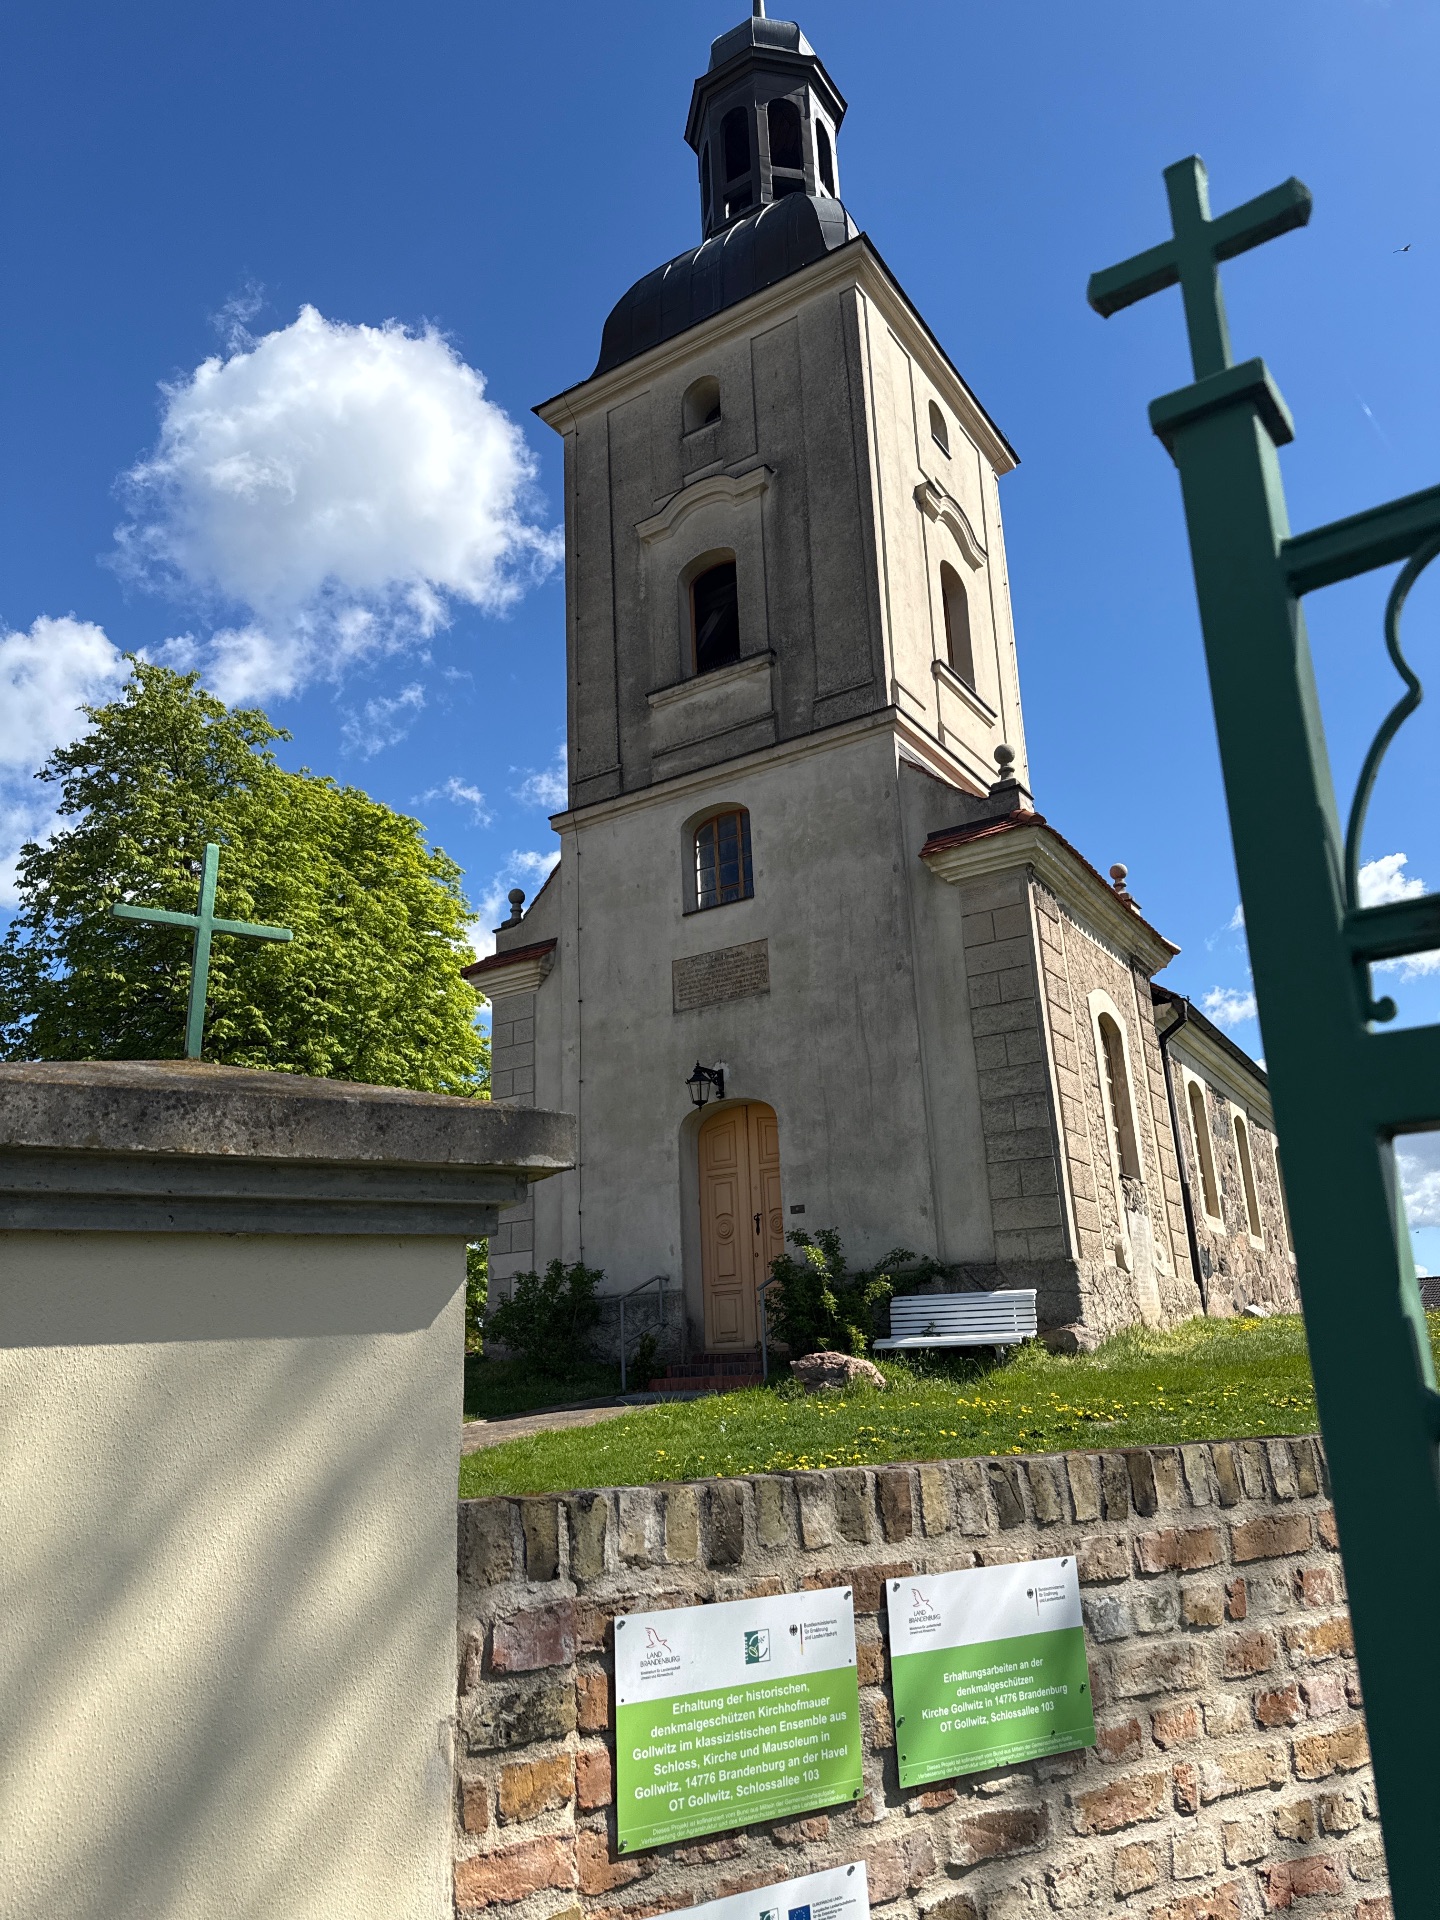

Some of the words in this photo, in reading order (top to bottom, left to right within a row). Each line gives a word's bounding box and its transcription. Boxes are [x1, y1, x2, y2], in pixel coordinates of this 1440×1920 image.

[913, 1609, 927, 1617] LAND
[640, 1655, 681, 1668] BRANDENBURG
[646, 1651, 663, 1660] LAND
[943, 1663, 1018, 1683] Erhaltungsarbeiten
[1019, 1661, 1029, 1669] an
[1030, 1658, 1044, 1667] der
[672, 1697, 724, 1715] Erhaltung
[726, 1694, 743, 1705] der
[746, 1683, 810, 1701] historischen,
[921, 1707, 949, 1720] Kirche
[951, 1700, 984, 1714] Gollwitz
[985, 1697, 993, 1707] in
[995, 1693, 1017, 1706] 14776
[1018, 1684, 1068, 1701] Brandenburg
[956, 1675, 1034, 1697] denkmalgeschützen
[650, 1710, 755, 1738] denkmalgeschützen
[758, 1696, 830, 1718] Kirchhofmauer
[940, 1721, 952, 1733] OT
[954, 1715, 989, 1730] Gollwitz,
[990, 1705, 1040, 1723] Schlossallee
[1041, 1700, 1055, 1712] 103
[632, 1743, 677, 1760] Gollwitz
[679, 1740, 693, 1751] im
[695, 1725, 777, 1748] klassizistischen
[779, 1714, 828, 1732] Ensemble
[829, 1711, 847, 1722] aus
[653, 1759, 700, 1776] Schloss,
[703, 1750, 737, 1766] Kirche
[740, 1744, 760, 1758] und
[762, 1735, 819, 1754] Mausoleum
[820, 1731, 830, 1741] in
[634, 1781, 682, 1799] Gollwitz,
[685, 1772, 716, 1788] 14776
[718, 1759, 786, 1781] Brandenburg
[788, 1756, 800, 1767] an
[802, 1752, 819, 1764] der
[821, 1745, 848, 1760] Havel
[669, 1797, 685, 1812] OT
[688, 1789, 733, 1807] Gollwitz,
[736, 1775, 800, 1797] Schlossallee
[802, 1769, 820, 1782] 103
